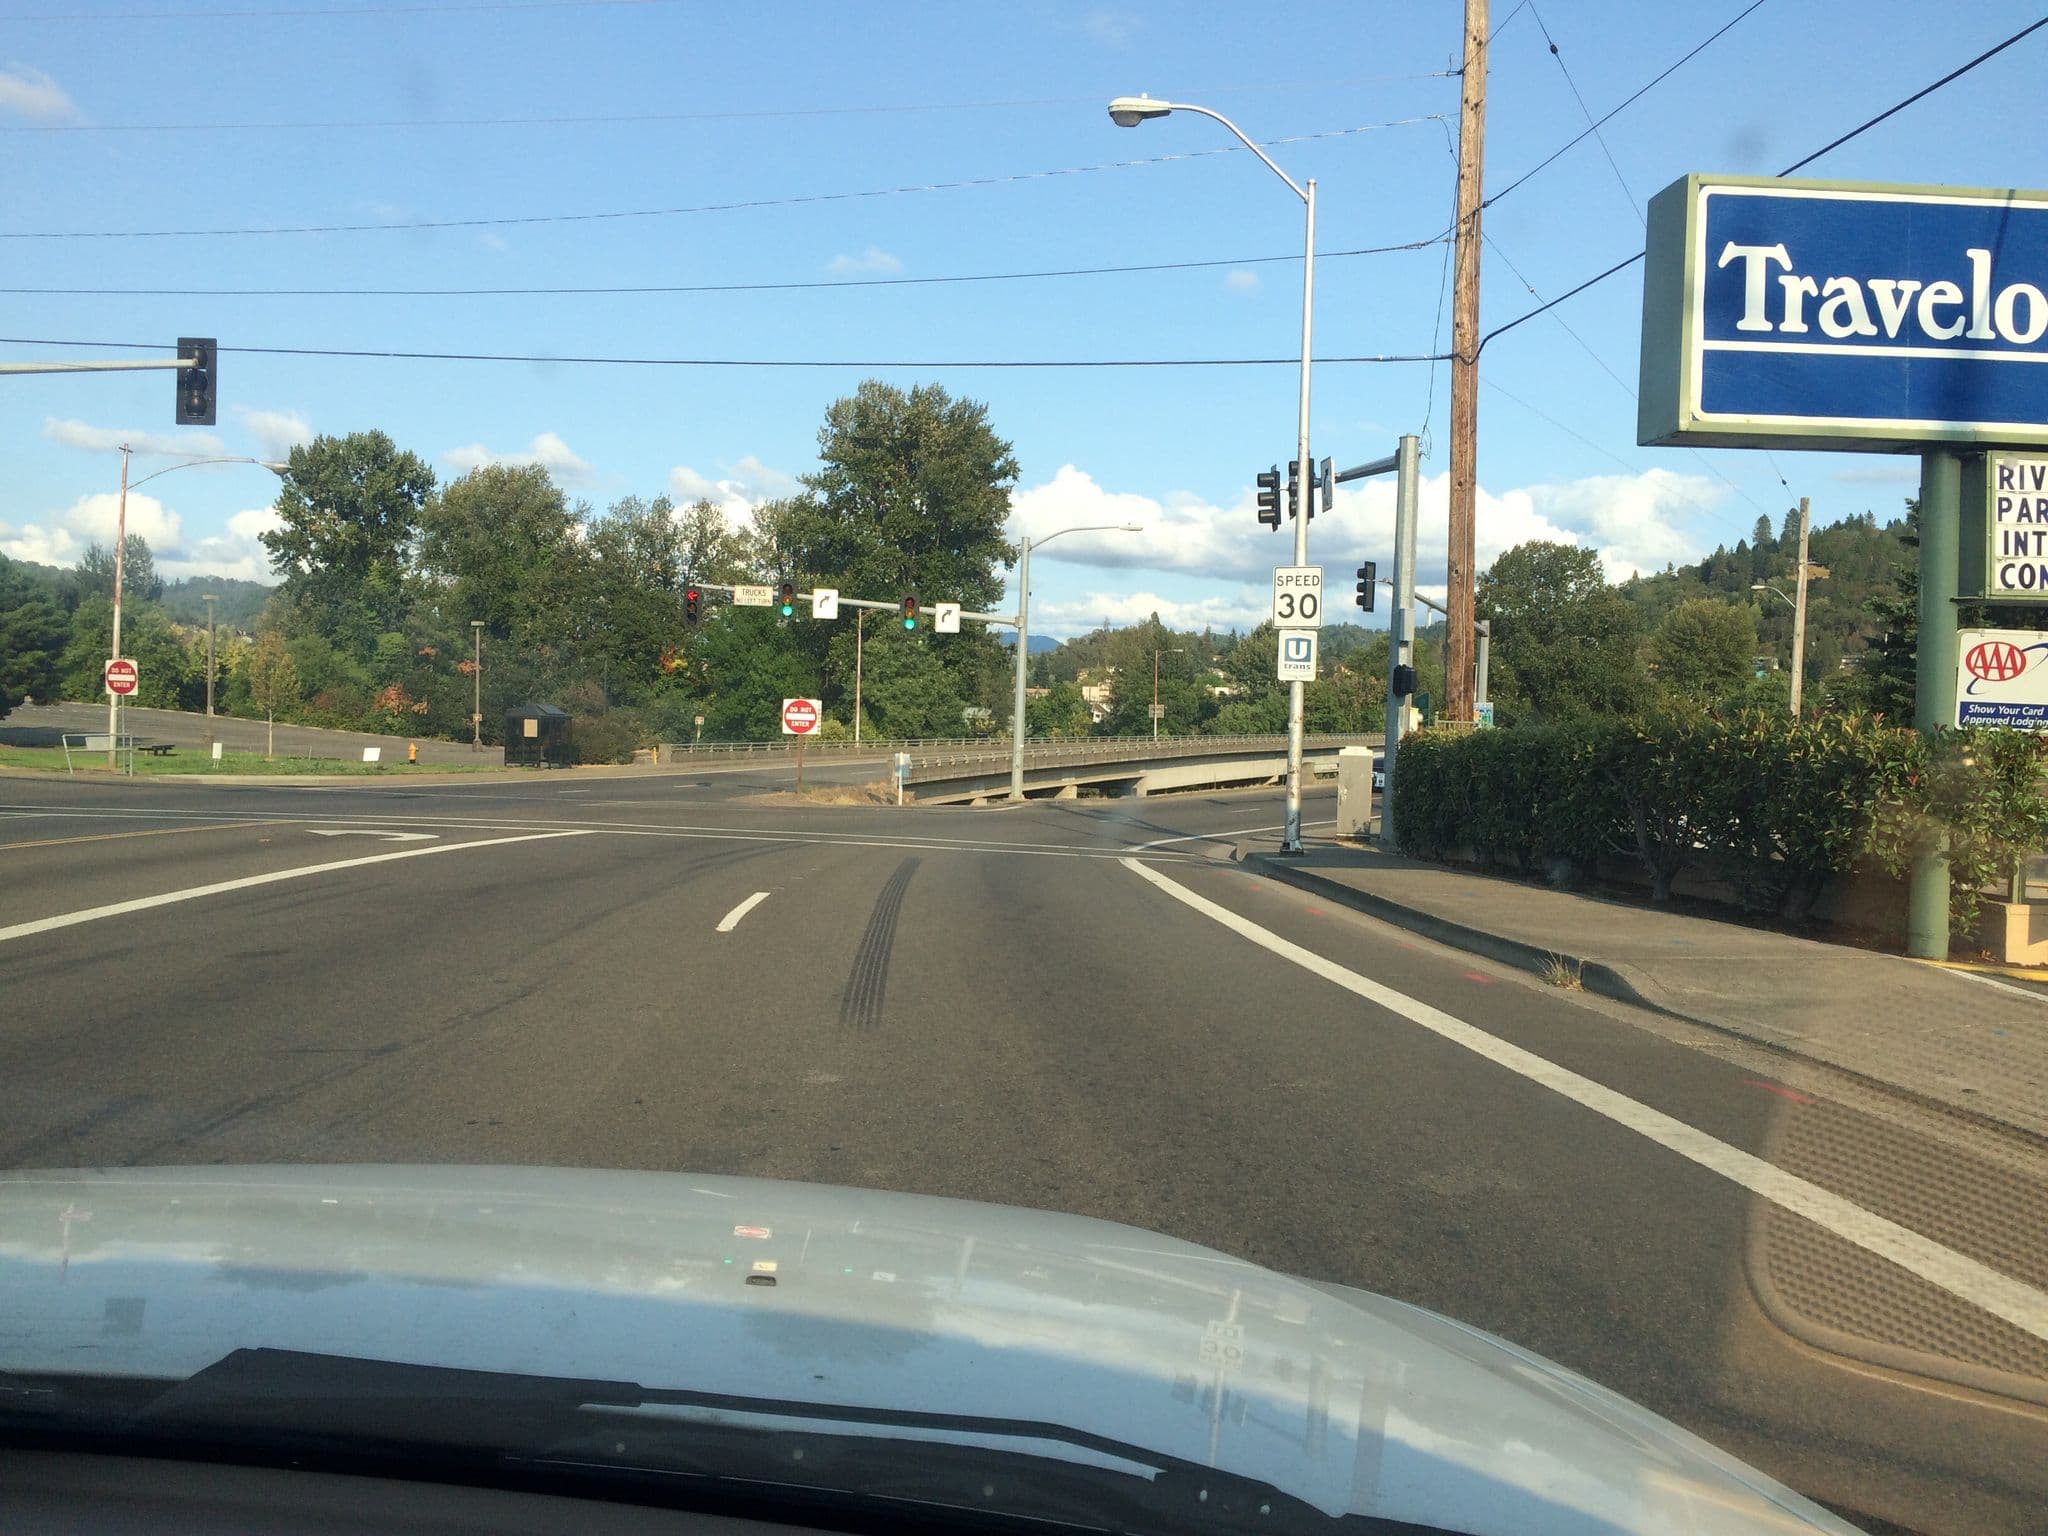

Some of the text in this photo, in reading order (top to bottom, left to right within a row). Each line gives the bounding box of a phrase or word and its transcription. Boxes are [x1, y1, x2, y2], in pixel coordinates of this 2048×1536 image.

[1718, 241, 2048, 344] Travelo
[1999, 465, 2046, 490] RIV
[1998, 497, 2048, 523] PAR
[2004, 530, 2047, 556] INT
[1277, 575, 1320, 586] SPEED
[742, 588, 767, 596] TRUCKS
[1278, 593, 1317, 619] 30
[1288, 640, 1308, 660] U
[1284, 663, 1311, 671] trans
[1969, 642, 2022, 681] AAA
[1962, 715, 2010, 726] Approved
[1968, 704, 2045, 716] Show Your Card
